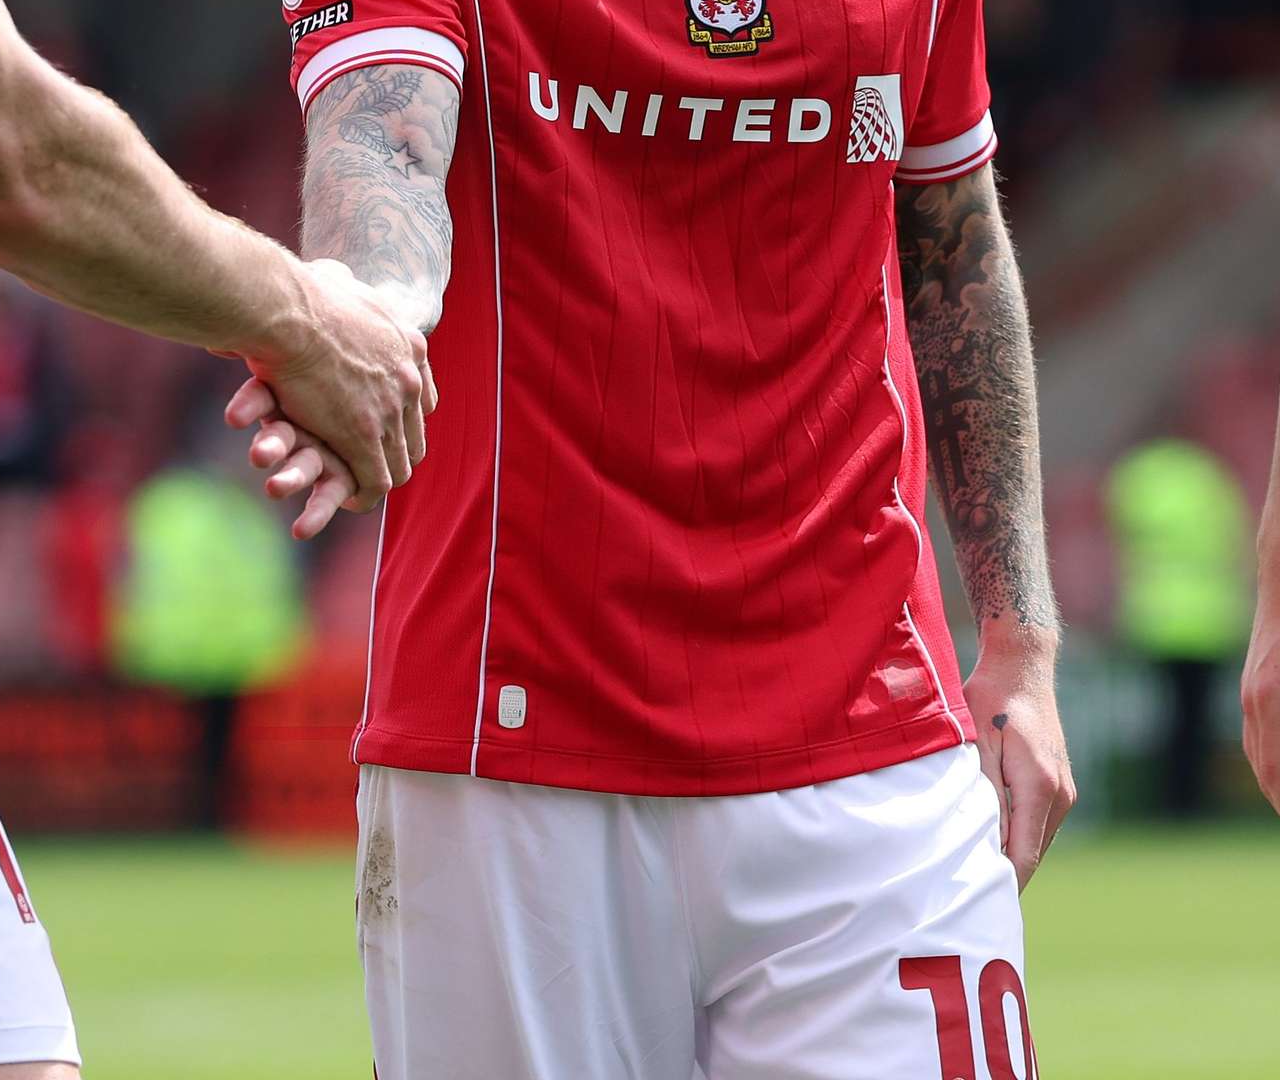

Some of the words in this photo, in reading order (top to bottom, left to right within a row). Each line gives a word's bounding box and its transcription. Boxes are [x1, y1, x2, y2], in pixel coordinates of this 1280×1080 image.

[290, 2, 350, 42] ETHER
[529, 71, 832, 143] UNITED
[899, 954, 1040, 1080] 10
